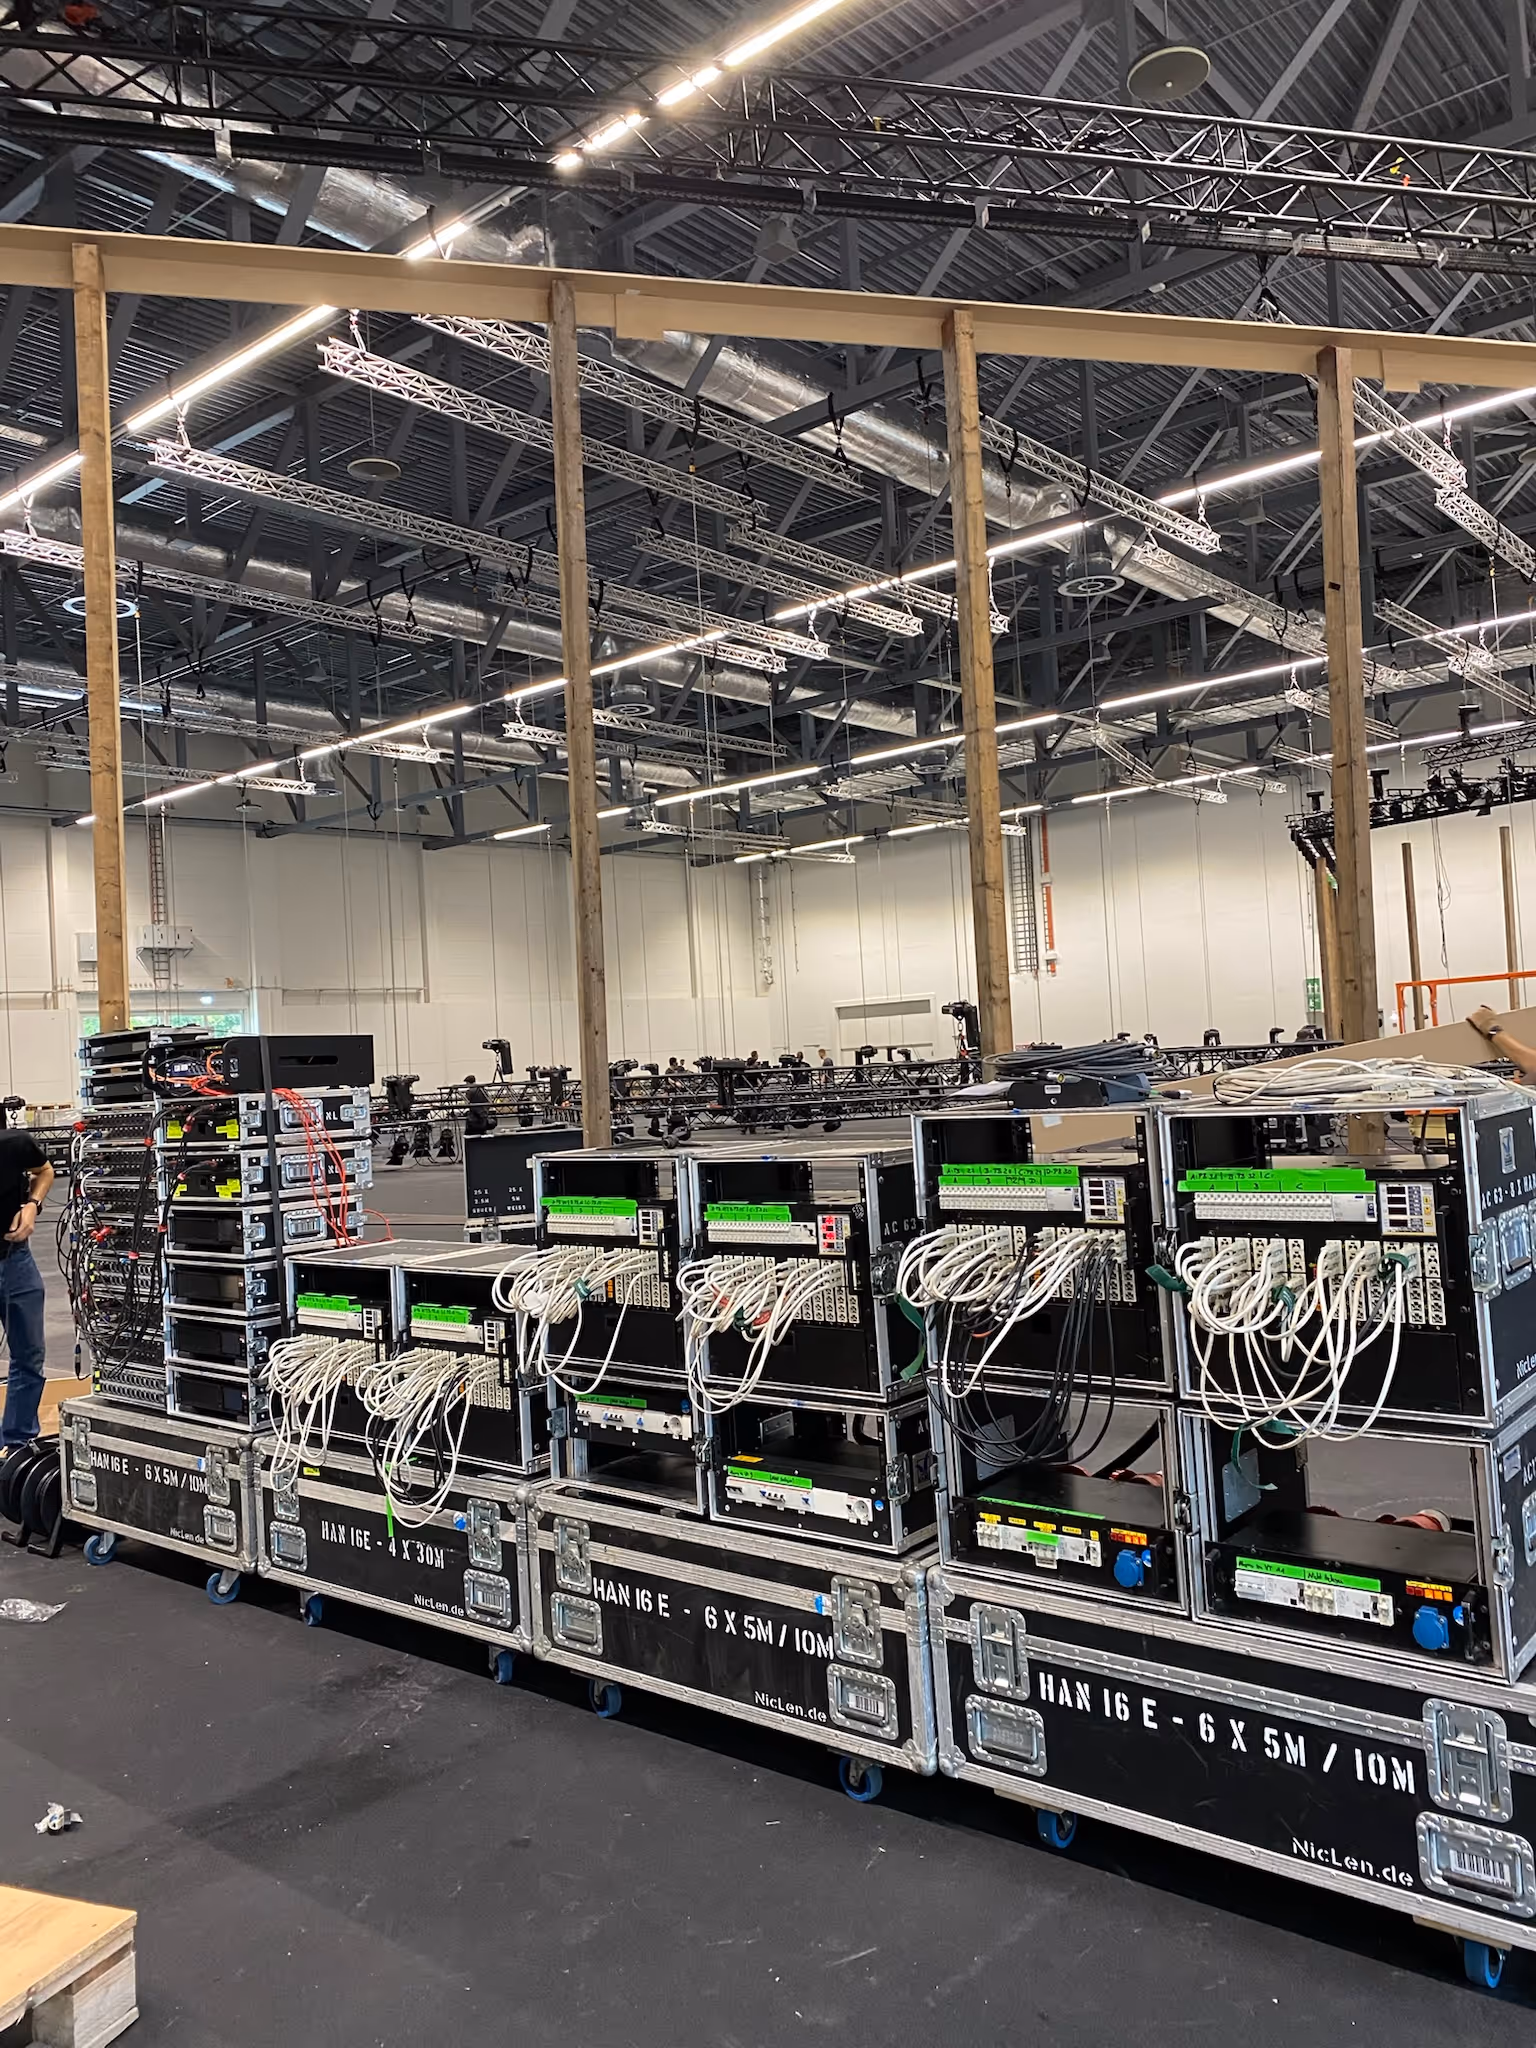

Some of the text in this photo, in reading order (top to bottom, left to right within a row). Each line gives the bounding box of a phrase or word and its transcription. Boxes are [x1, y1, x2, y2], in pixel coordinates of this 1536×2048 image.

[1481, 1190, 1492, 1210] AC
[884, 1218, 917, 1236] AC 63
[90, 1451, 109, 1469] HAN
[111, 1455, 120, 1473] 16
[122, 1458, 129, 1475] E
[145, 1463, 151, 1480] 6
[154, 1466, 162, 1483] X
[164, 1467, 178, 1488] 5M
[321, 1520, 346, 1543] HAN
[388, 1536, 397, 1557] 4
[402, 1540, 410, 1561] X
[416, 1545, 445, 1569] 30M
[414, 1593, 464, 1617] NicLen.de
[593, 1576, 630, 1607] HAN
[635, 1588, 652, 1612] 16
[658, 1594, 670, 1618] E
[704, 1605, 718, 1629] 6
[724, 1610, 738, 1636] X
[743, 1616, 773, 1647] 5M
[795, 1627, 834, 1660] 10M
[754, 1690, 827, 1724] NicLen.de
[1038, 1673, 1092, 1713] HAN
[1103, 1687, 1130, 1721] 16
[1142, 1698, 1159, 1730] E
[1199, 1712, 1216, 1744] 6
[1228, 1719, 1247, 1753] X
[1264, 1727, 1306, 1768] 5M
[1322, 1743, 1339, 1774] /
[1355, 1747, 1416, 1795] 10M
[1292, 1837, 1415, 1887] NicLen.de
